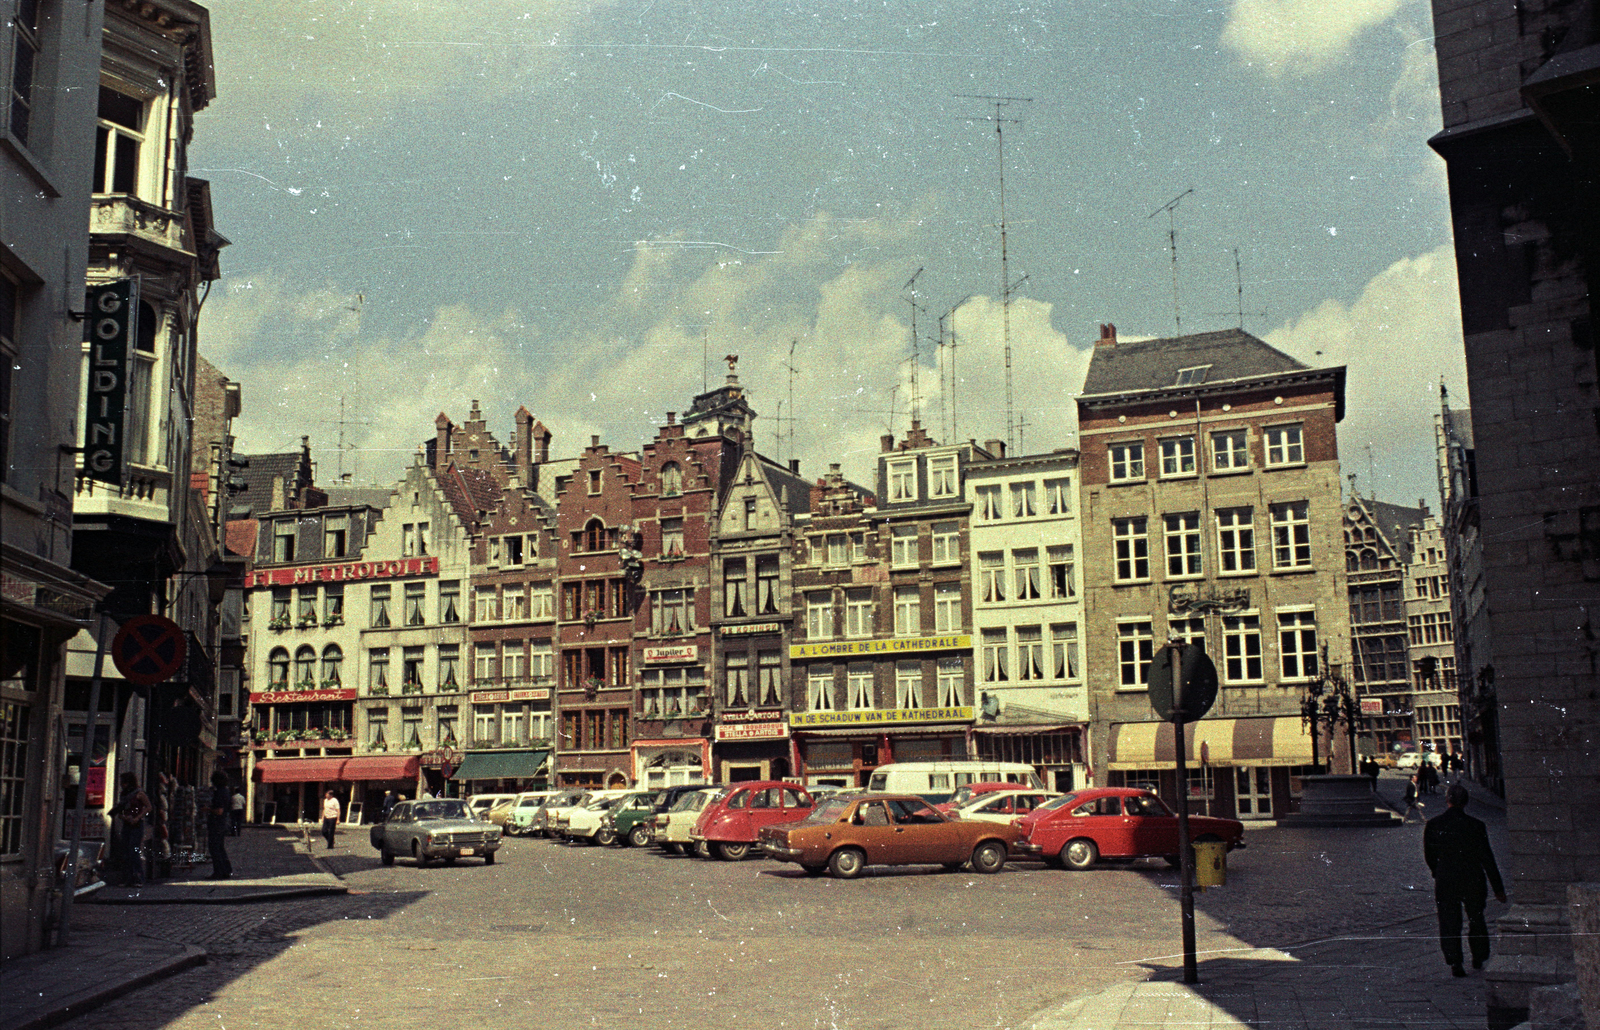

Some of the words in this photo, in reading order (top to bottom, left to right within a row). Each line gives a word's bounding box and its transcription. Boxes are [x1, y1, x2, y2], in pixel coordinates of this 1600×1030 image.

[90, 291, 122, 472] GOLDING
[294, 559, 434, 584] METROPOLE
[799, 647, 806, 656] A
[858, 643, 870, 652] DE
[875, 642, 887, 651] LA
[892, 638, 959, 650] CATHEDRALE
[260, 689, 347, 702] Restaurant
[722, 713, 750, 721] STELLA
[753, 711, 780, 720] ARTOIS
[794, 715, 803, 724] IN
[806, 714, 816, 723] DE
[820, 713, 861, 723] SCHADUW
[865, 711, 882, 721] VAN
[886, 711, 897, 720] DE
[901, 708, 966, 720] KATHEDRAAL
[724, 730, 748, 738] STELLA
[754, 728, 779, 737] ARTOIS
